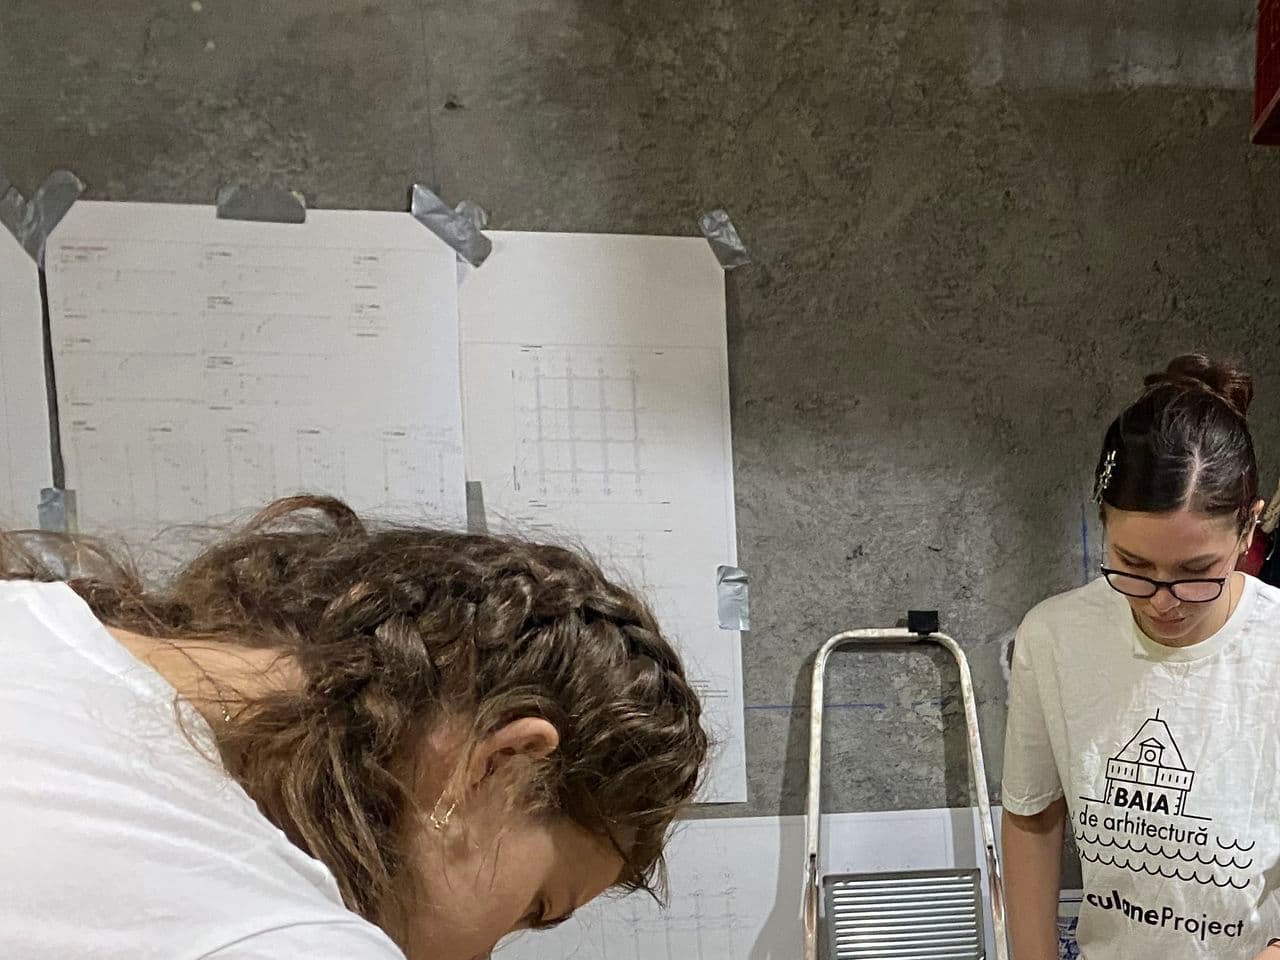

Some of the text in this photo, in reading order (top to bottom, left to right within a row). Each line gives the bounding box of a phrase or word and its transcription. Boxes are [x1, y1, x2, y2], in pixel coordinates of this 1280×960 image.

[1114, 787, 1169, 815] BAIA
[1079, 804, 1208, 846] de arhitectură
